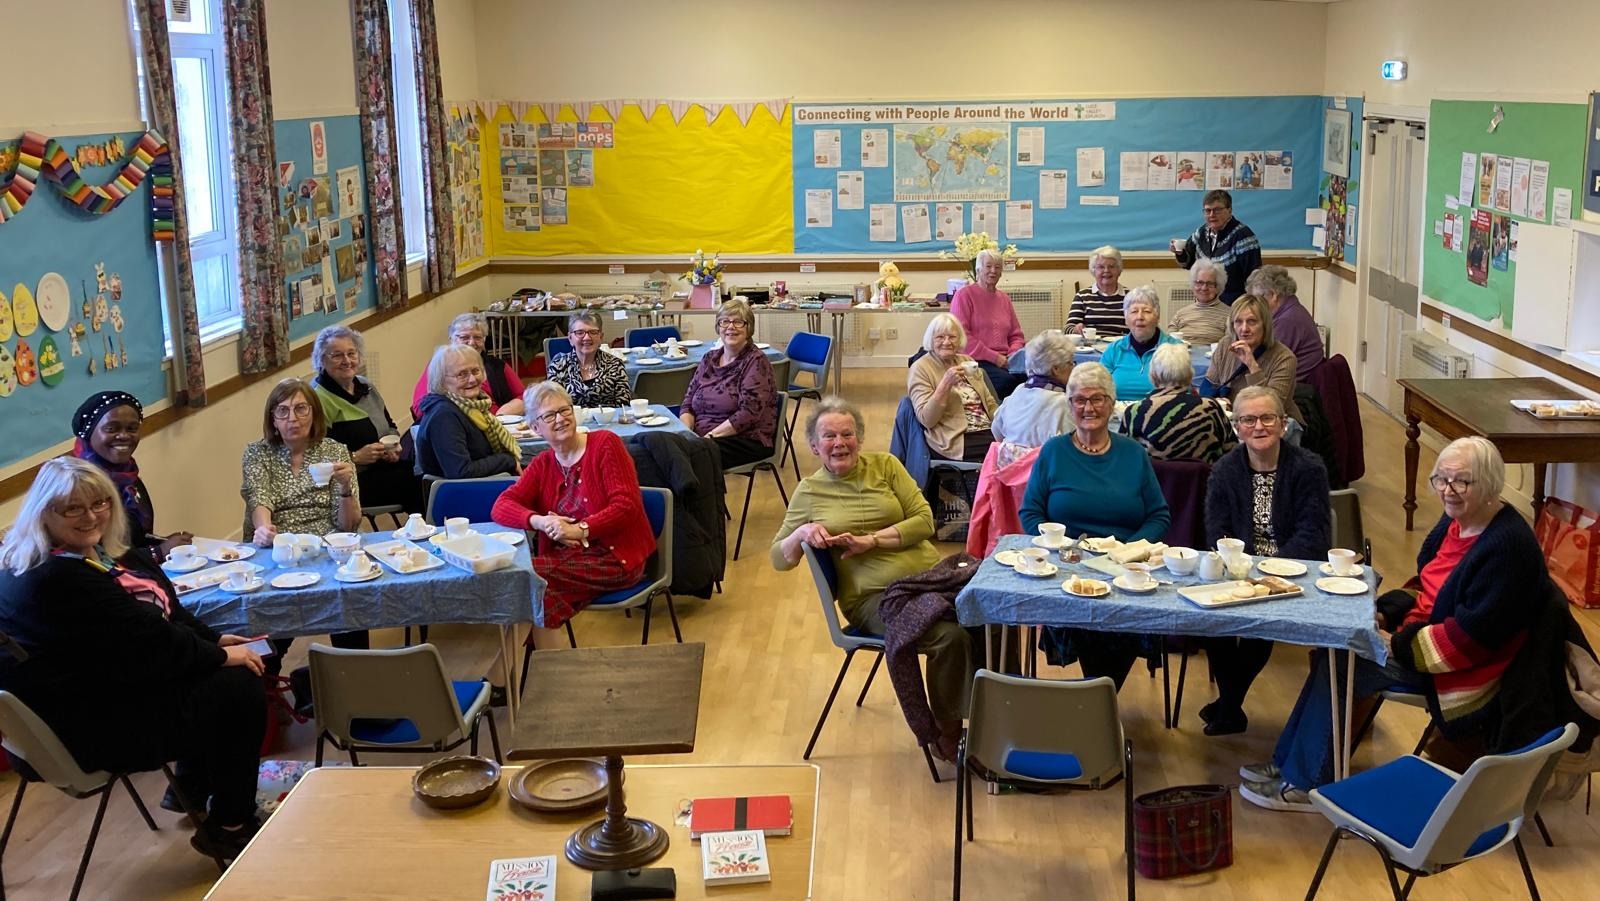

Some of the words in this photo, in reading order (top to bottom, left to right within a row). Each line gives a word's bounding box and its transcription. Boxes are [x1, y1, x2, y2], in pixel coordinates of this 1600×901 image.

[798, 108, 871, 121] Connecting
[876, 107, 902, 119] with
[906, 107, 950, 121] People
[954, 106, 1000, 118] Around
[1004, 107, 1026, 119] the
[1030, 107, 1069, 118] World
[578, 133, 613, 143] OOPS
[944, 500, 967, 511] THIS
[944, 512, 969, 521] JUST
[712, 834, 755, 844] MISSION
[501, 860, 546, 871] MISSION
